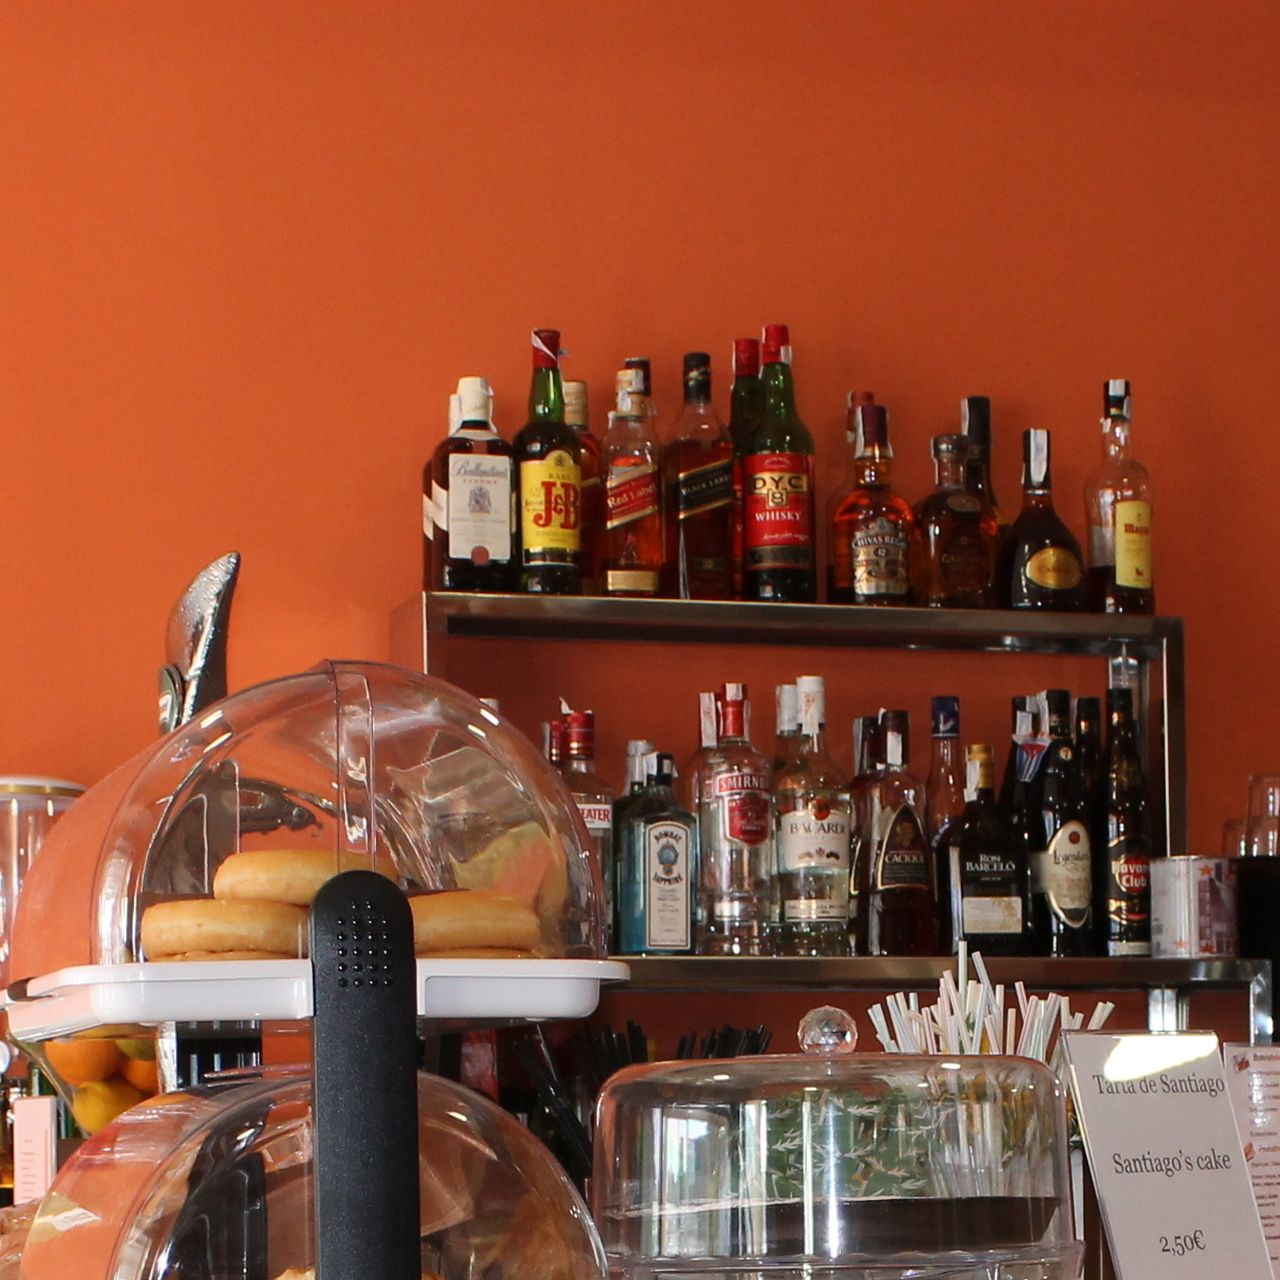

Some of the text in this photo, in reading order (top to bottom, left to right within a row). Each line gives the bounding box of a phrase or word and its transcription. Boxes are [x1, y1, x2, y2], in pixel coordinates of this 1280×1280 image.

[752, 476, 806, 490] DYC
[533, 481, 581, 530] J&B
[755, 511, 801, 522] WHISKY
[852, 535, 884, 550] CHIVAS
[580, 808, 610, 822] EATER
[979, 853, 1002, 863] RON
[1121, 874, 1148, 888] Club
[1140, 1077, 1157, 1094] de
[1160, 1072, 1225, 1098] Santiago
[1112, 1150, 1194, 1178] Santiago's
[1196, 1148, 1232, 1172] cake
[1159, 1229, 1207, 1256] 2,50€
